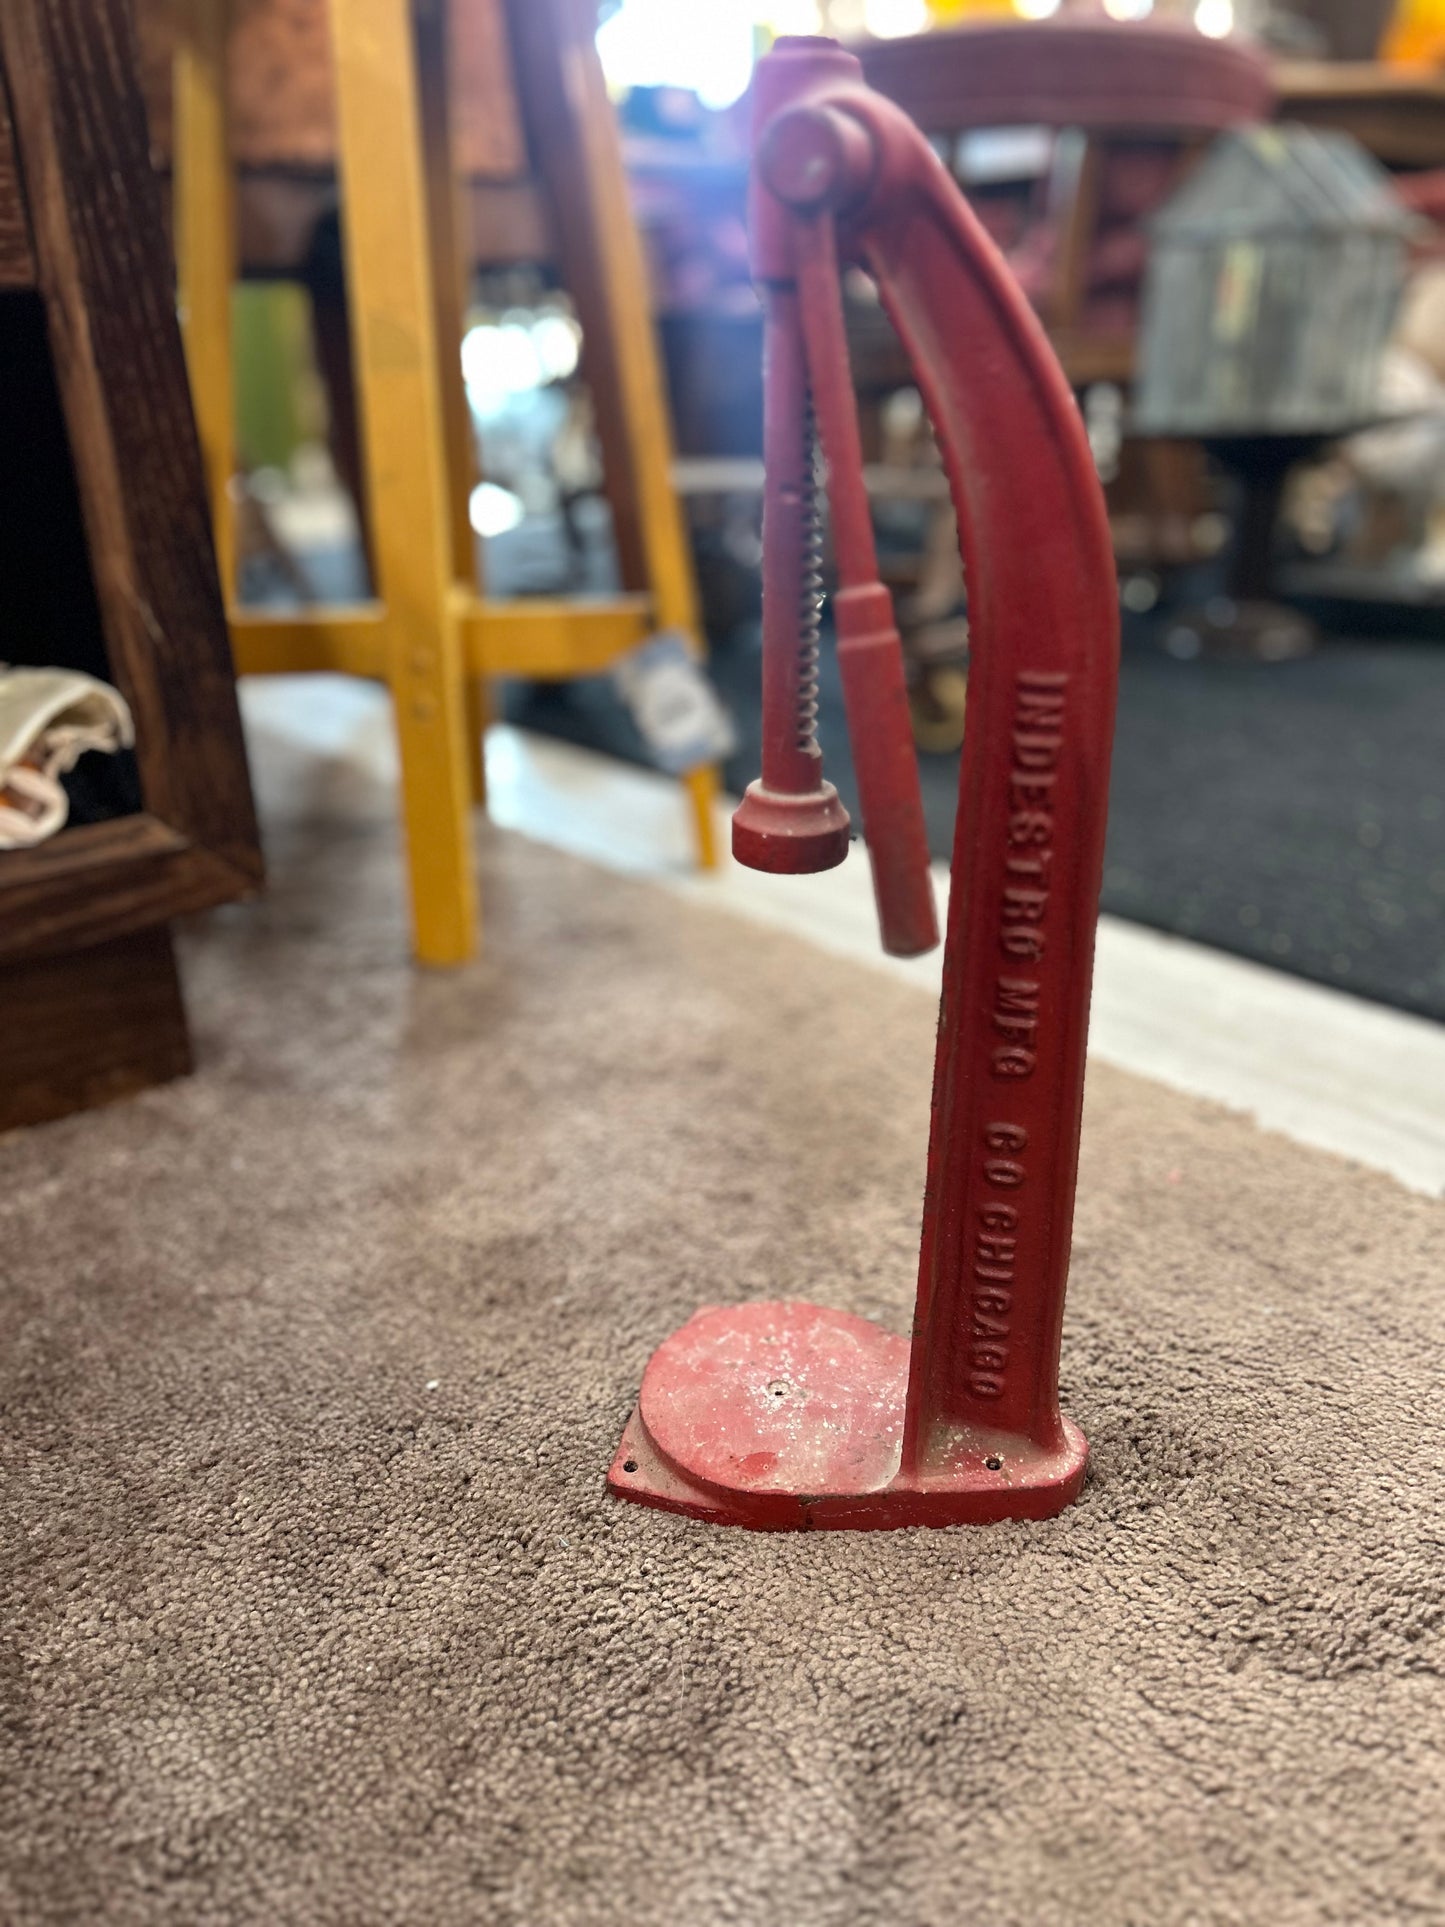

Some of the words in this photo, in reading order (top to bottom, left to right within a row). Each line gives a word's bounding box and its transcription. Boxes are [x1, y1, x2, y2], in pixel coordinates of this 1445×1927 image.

[1002, 672, 1068, 961] INDESTRO
[993, 977, 1040, 1077] MFG
[983, 1121, 1027, 1186] CO
[969, 1203, 1017, 1397] CHICAGO
